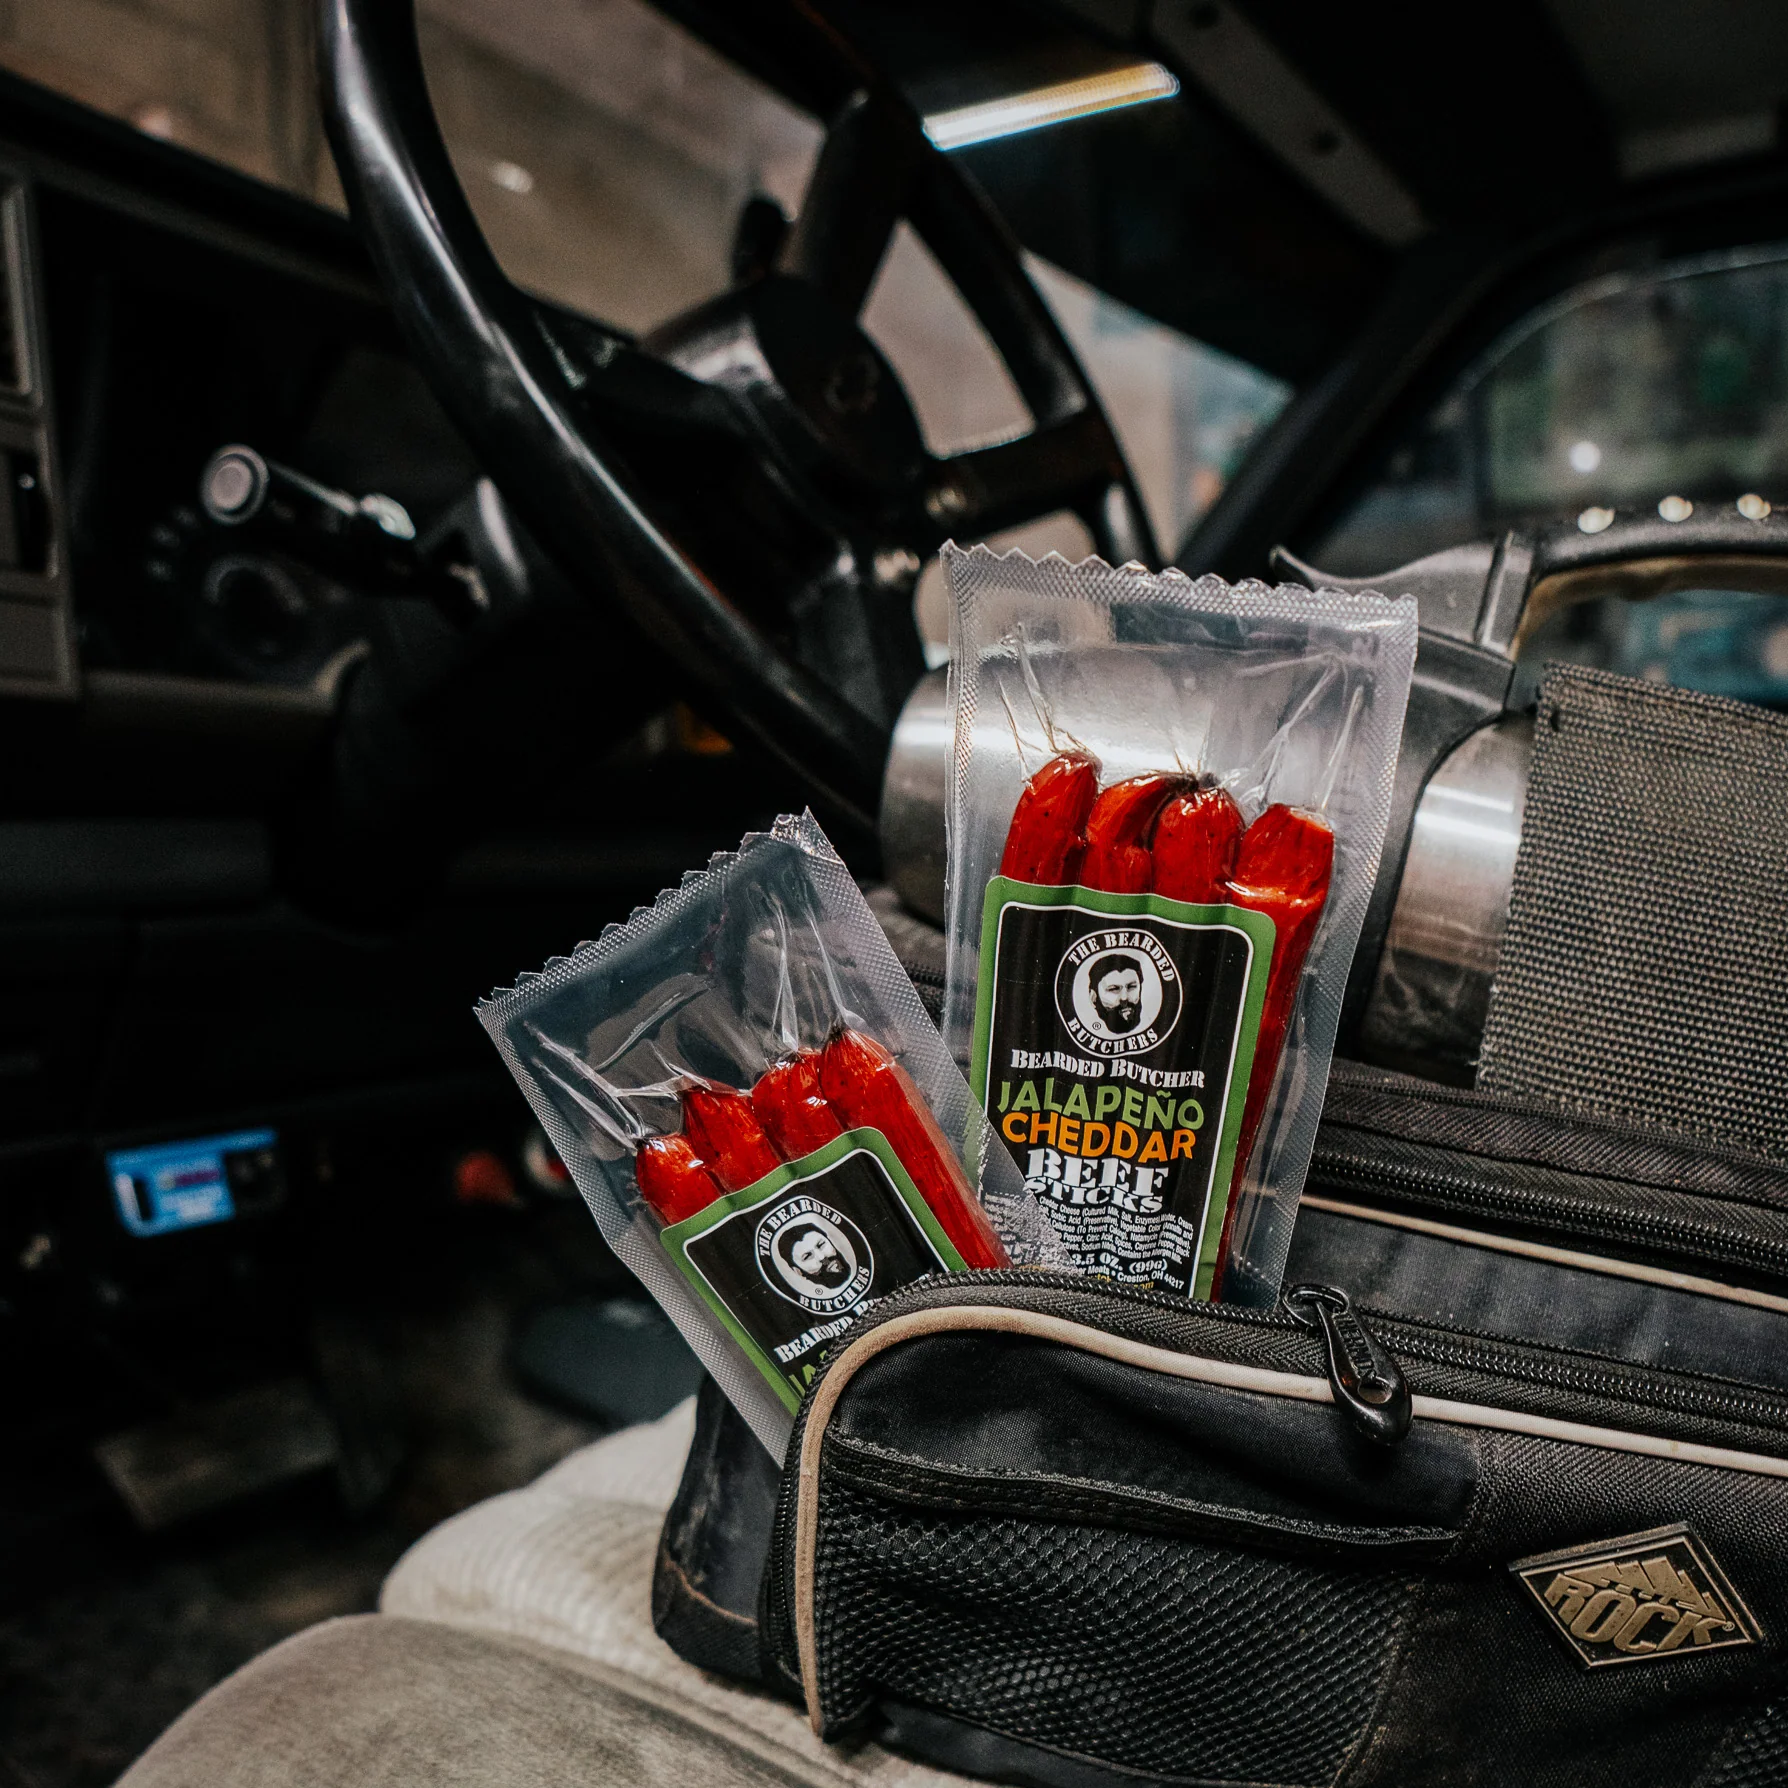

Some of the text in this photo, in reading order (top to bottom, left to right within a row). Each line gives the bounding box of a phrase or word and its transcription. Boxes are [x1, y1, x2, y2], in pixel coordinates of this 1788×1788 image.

[1068, 932, 1175, 982] THE BEARDED
[1068, 1017, 1159, 1054] BUTCHERS
[1010, 1049, 1204, 1088] BEARDED BUTCHER
[997, 1077, 1205, 1130] JALAPEÑO
[1002, 1112, 1196, 1163] CHEDDAR
[1024, 1177, 1163, 1213] STICKS
[1025, 1148, 1169, 1198] BEEF
[759, 1199, 843, 1257] THE BEARDED
[1072, 1253, 1095, 1265] 3.5
[1099, 1252, 1123, 1270] OZ.
[1117, 1271, 1150, 1284] Creston,
[1151, 1270, 1164, 1280] OH
[1164, 1273, 1184, 1289] 44217
[799, 1265, 871, 1313] BUTCHERS
[773, 1316, 854, 1363] BEARDED
[1544, 1573, 1726, 1654] ROCK
